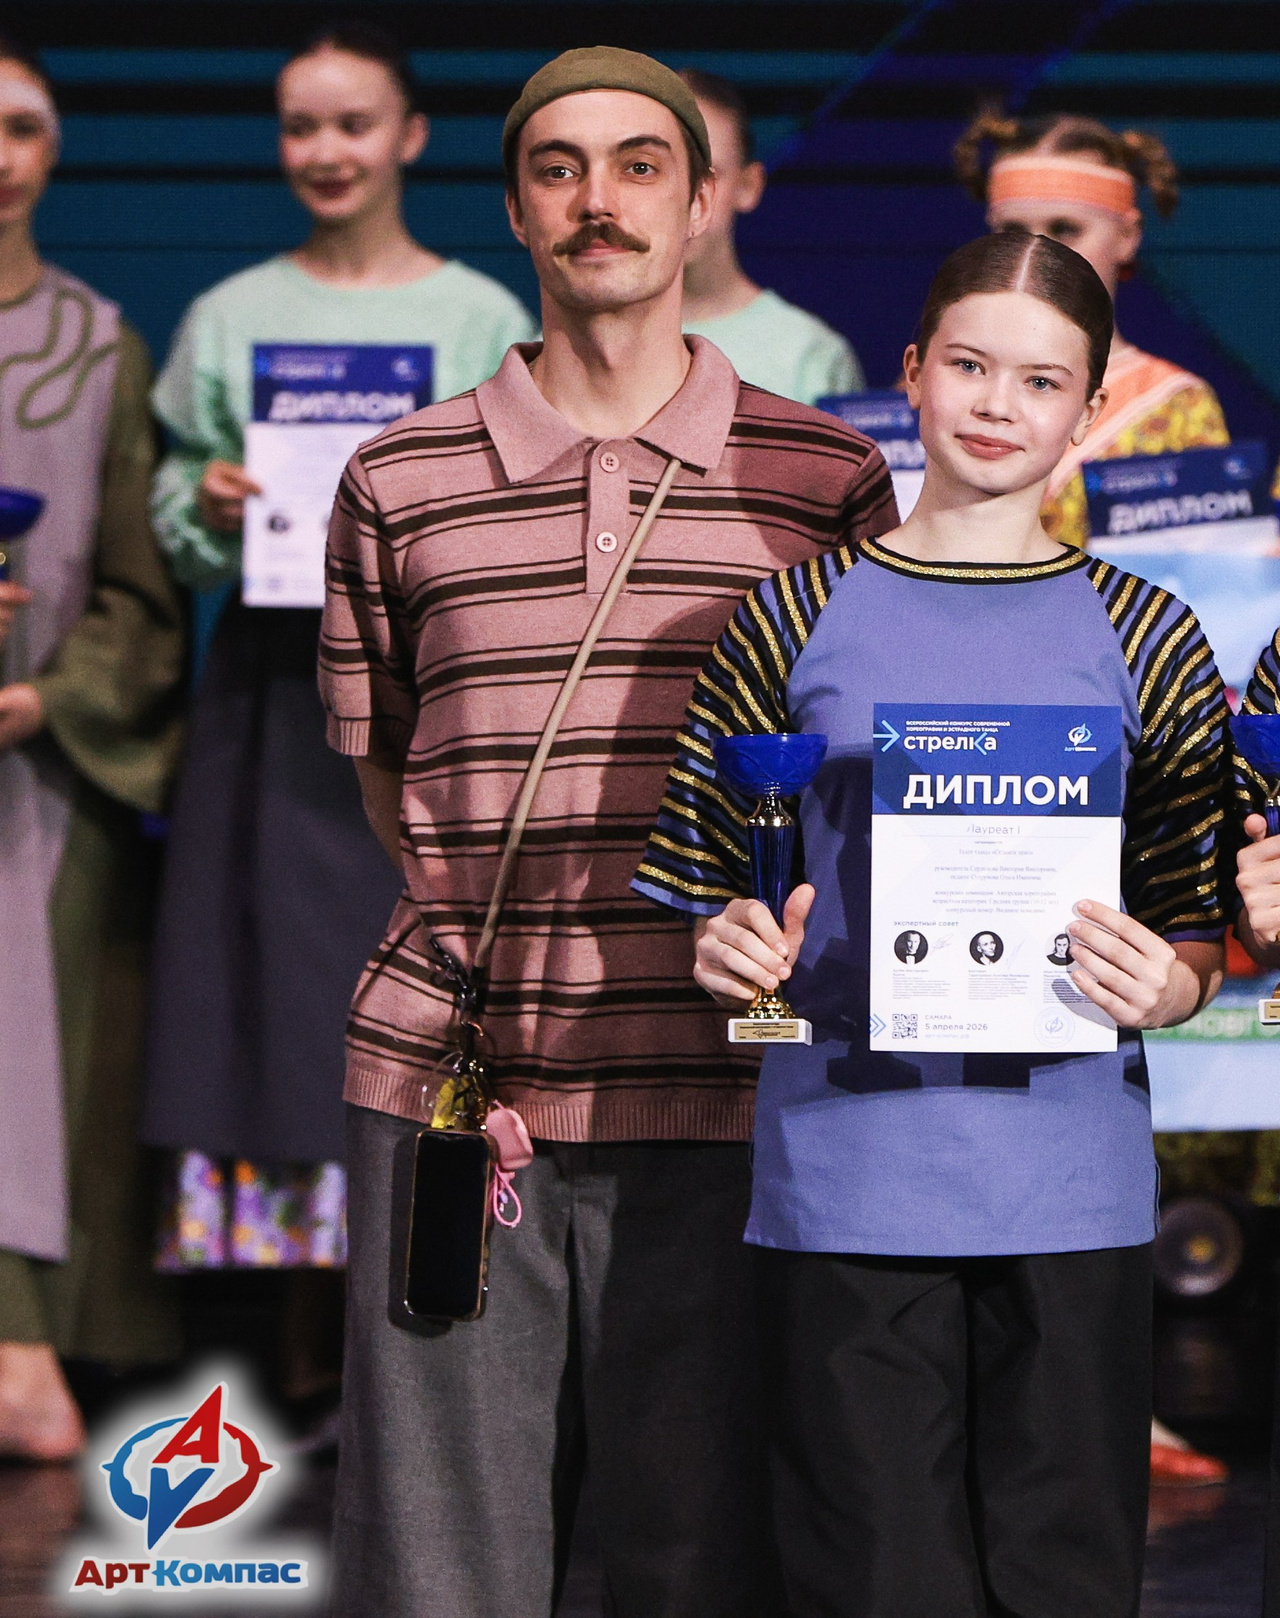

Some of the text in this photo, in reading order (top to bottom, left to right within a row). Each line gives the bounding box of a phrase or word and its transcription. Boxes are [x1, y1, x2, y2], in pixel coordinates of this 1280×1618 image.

[903, 732, 997, 756] стрелка
[903, 774, 1089, 810] ДИПЛОМ
[966, 1023, 988, 1031] 2026
